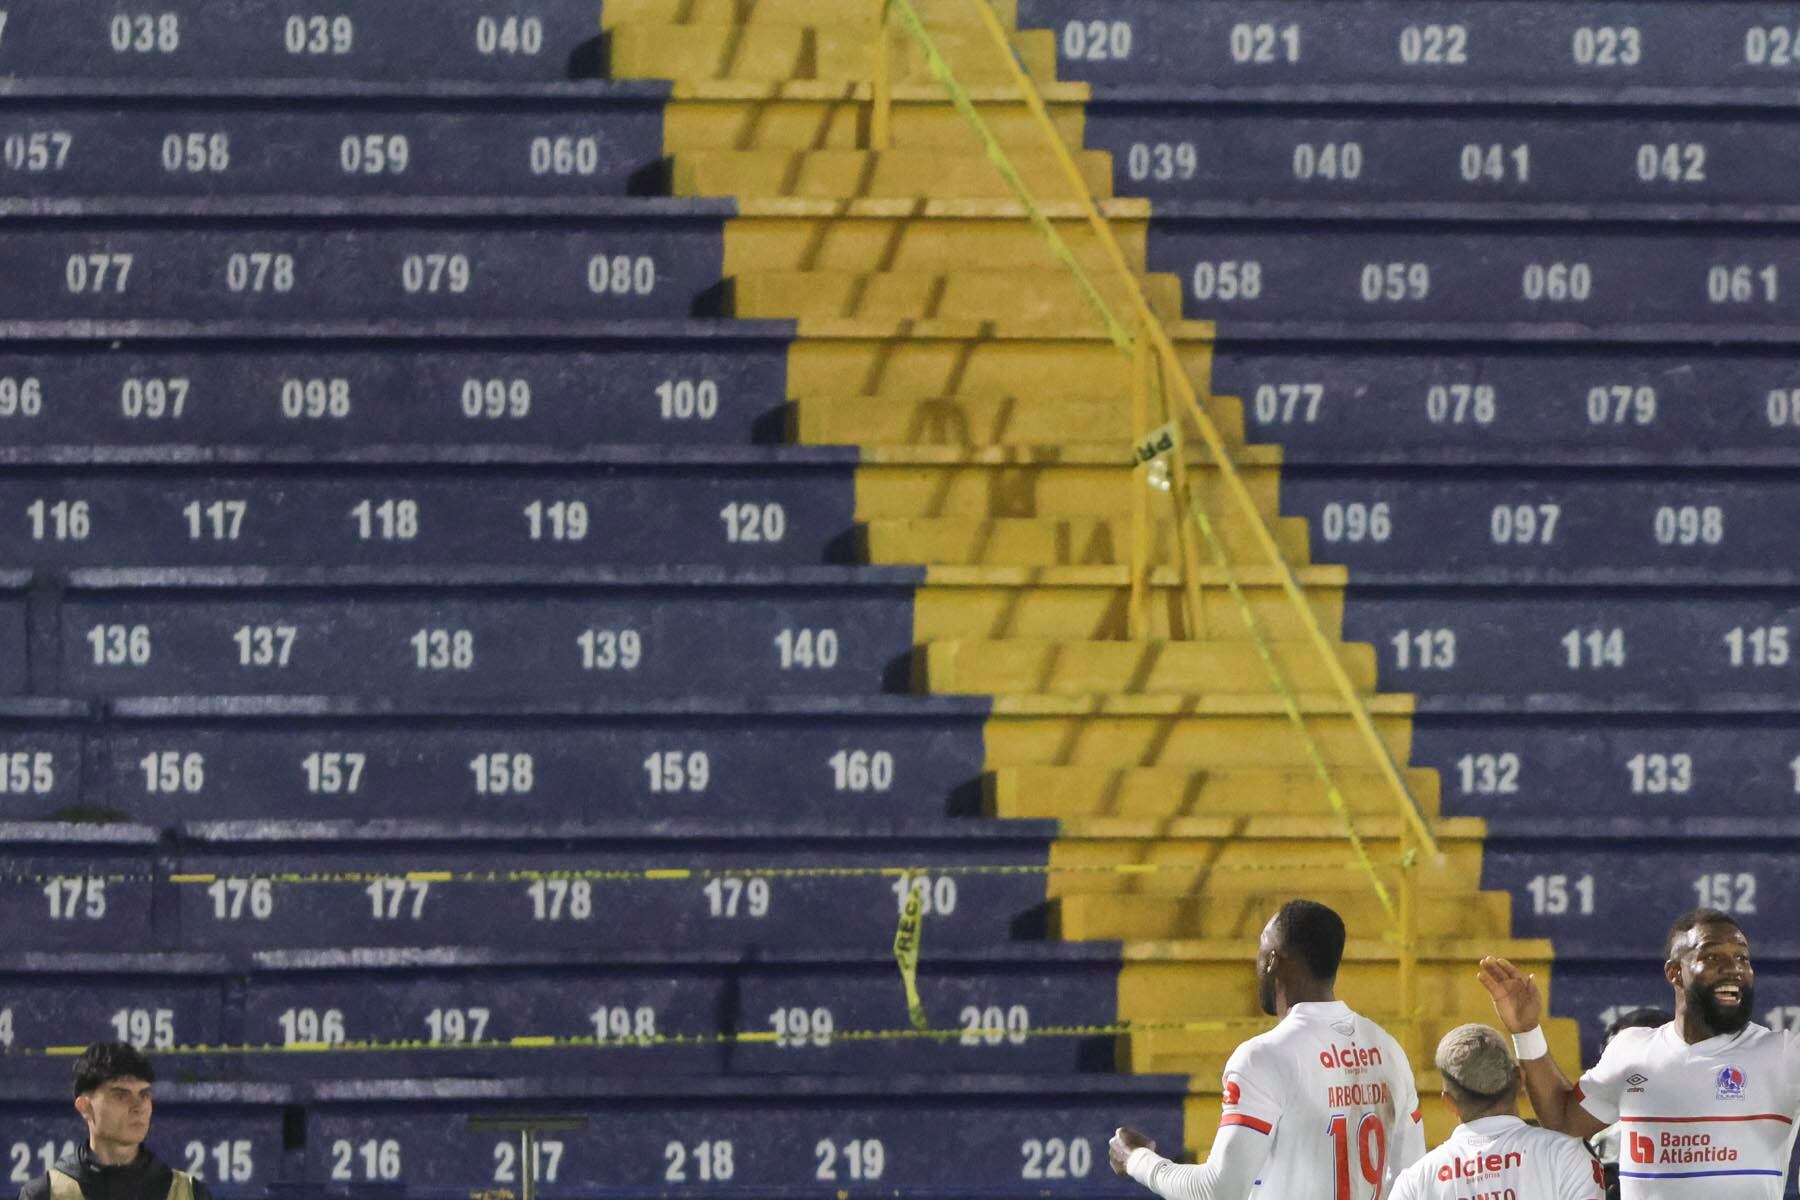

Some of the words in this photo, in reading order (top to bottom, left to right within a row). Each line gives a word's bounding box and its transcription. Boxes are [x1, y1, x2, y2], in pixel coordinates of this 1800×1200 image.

[109, 13, 180, 52] 038
[475, 17, 543, 54] 040
[1063, 20, 1133, 59] 020
[1399, 24, 1468, 64] 022
[340, 135, 409, 173] 059
[530, 137, 599, 174] 060
[1293, 143, 1362, 179] 040
[1460, 145, 1529, 180] 041
[65, 254, 134, 291] 077
[226, 253, 294, 291] 078
[587, 255, 656, 294] 080
[1193, 261, 1262, 300] 058
[1522, 263, 1592, 299] 060
[1707, 266, 1777, 301] 061
[281, 379, 351, 417] 098
[461, 379, 531, 417] 099
[1255, 383, 1325, 422] 077
[1426, 384, 1496, 423] 078
[183, 501, 247, 539] 117
[523, 501, 589, 540] 119
[719, 503, 786, 542] 120
[1490, 504, 1561, 543] 097
[1654, 506, 1724, 544] 098
[86, 624, 152, 665] 136
[410, 629, 475, 669] 138
[773, 628, 839, 668] 140
[1392, 628, 1457, 668] 113
[1723, 626, 1790, 666] 115
[139, 751, 205, 792] 156
[301, 752, 366, 792] 157
[643, 751, 710, 791] 159
[1457, 752, 1521, 793] 132
[1626, 753, 1693, 793] 133
[42, 877, 107, 918] 175
[207, 878, 274, 919] 176
[366, 872, 430, 918] 177
[527, 878, 592, 919] 178
[702, 877, 770, 917] 179
[1527, 875, 1595, 914] 151
[1693, 873, 1757, 913] 152
[1320, 1041, 1382, 1069] alcien
[1328, 1083, 1389, 1108] ARBOLEDA
[1021, 1138, 1092, 1179] 220
[1660, 1146, 1738, 1164] Atlántida
[1661, 1131, 1711, 1147] Banco
[331, 1139, 401, 1179] 216
[664, 1140, 735, 1181] 218
[814, 1139, 886, 1180] 219
[1438, 1150, 1521, 1182] alcien
